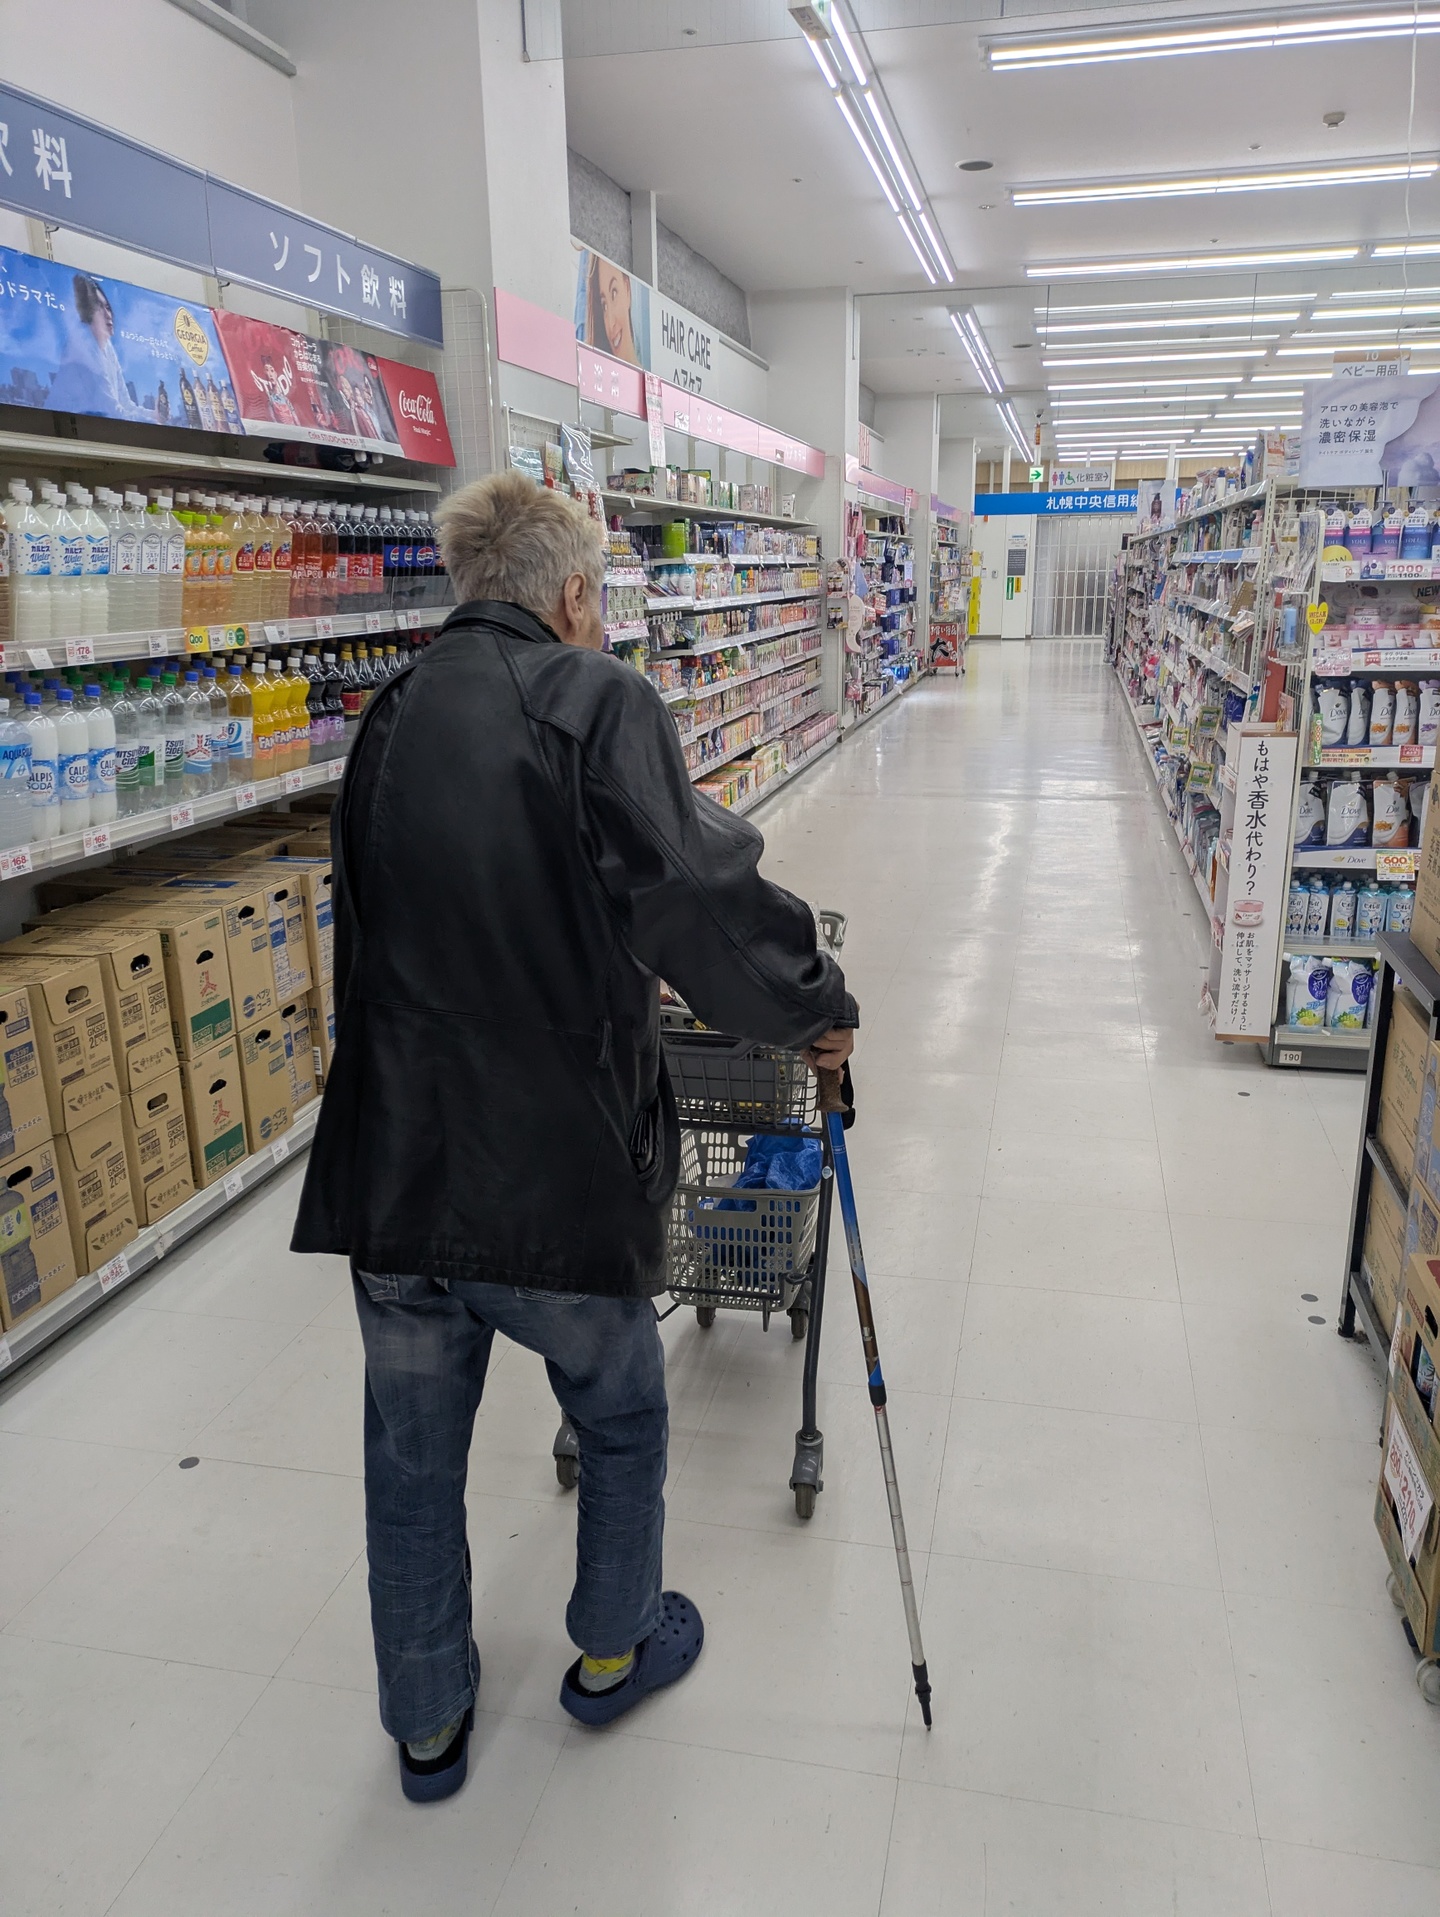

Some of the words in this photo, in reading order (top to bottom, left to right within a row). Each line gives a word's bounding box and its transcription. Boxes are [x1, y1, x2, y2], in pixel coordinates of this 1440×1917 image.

[269, 230, 407, 320] ソフト飲料
[176, 328, 207, 345] GEORGIA
[661, 309, 686, 358] HAIR
[687, 326, 711, 371] CARE
[1342, 364, 1398, 377] ベビー用品
[1320, 401, 1399, 413] アロマの美容泡で
[1319, 416, 1376, 429] 洗いながら
[1318, 429, 1376, 444] 濃密保湿
[1076, 472, 1104, 483] 化粧室
[1389, 564, 1424, 573] 1000
[189, 633, 203, 644] Qoo
[77, 646, 90, 655] 178
[1245, 740, 1269, 896] もはや香水代わり?
[93, 834, 106, 844] 168
[12, 855, 26, 866] 168
[1346, 855, 1367, 864] Dove
[1383, 856, 1407, 864] 600
[1239, 931, 1255, 1031] お肌をマッサージするように
[256, 988, 271, 1000] ペプシ
[257, 999, 272, 1012] コーラ
[1283, 1053, 1300, 1061] 190
[271, 1106, 287, 1120] ペプシ
[273, 1116, 288, 1131] コーラ
